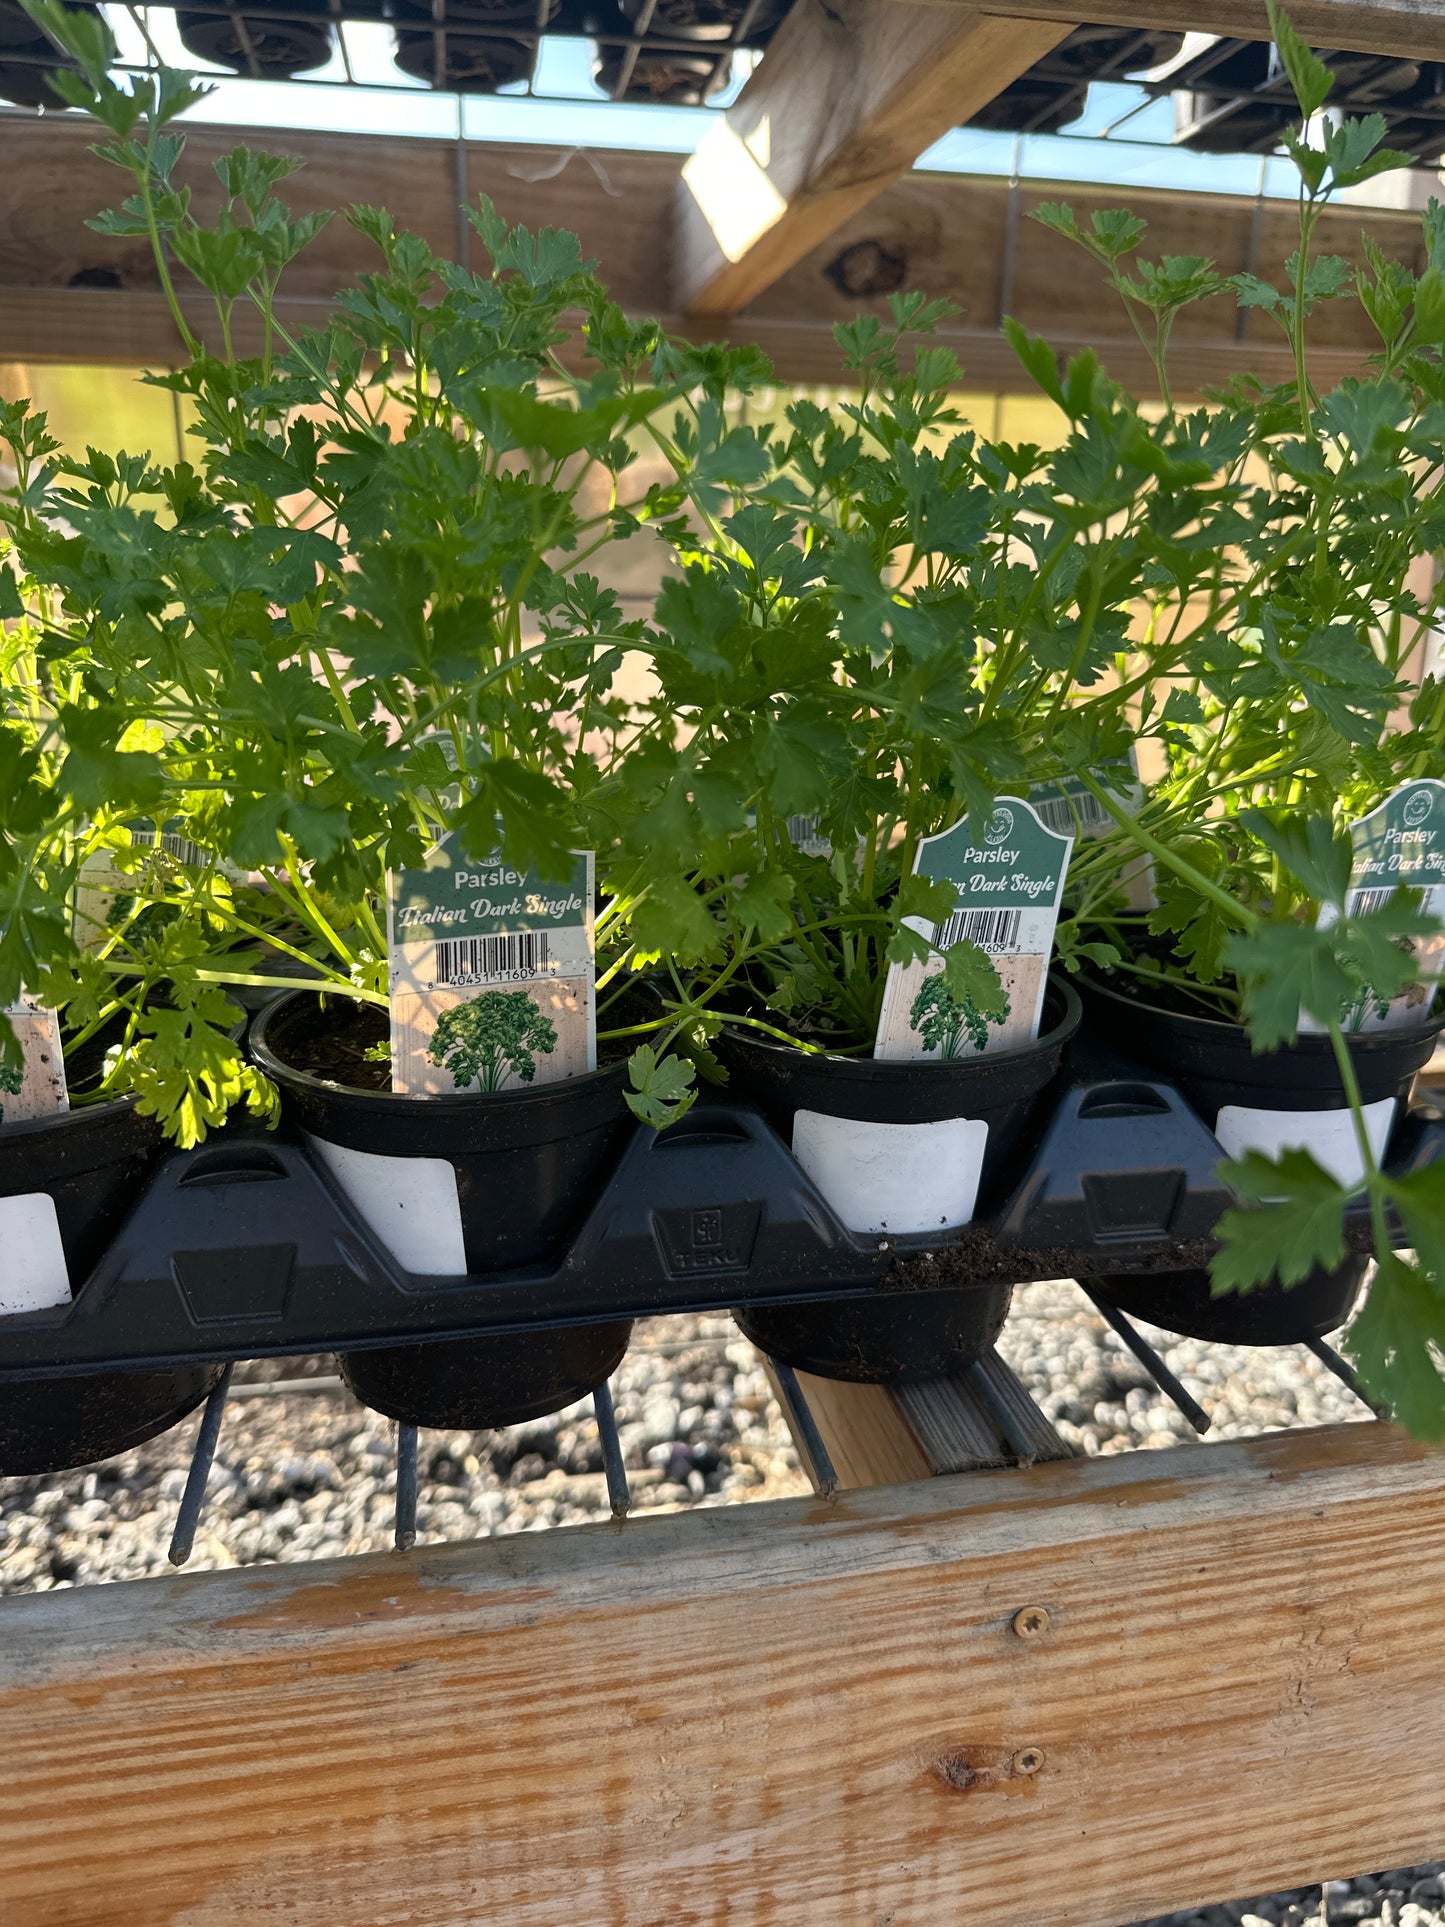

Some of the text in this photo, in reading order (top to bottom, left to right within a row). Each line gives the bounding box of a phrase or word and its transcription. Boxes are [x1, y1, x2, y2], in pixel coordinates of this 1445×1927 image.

[1384, 827, 1437, 845] Parsley
[963, 846, 1020, 866] Parsley
[1388, 853, 1424, 871] Dark
[1425, 852, 1445, 876] Sin
[455, 868, 528, 889] Parsley
[969, 874, 1008, 892] Dark
[1010, 873, 1055, 899] Single
[399, 893, 582, 927] Italian Dark Single
[427, 967, 556, 989] 8 40451 11609 3
